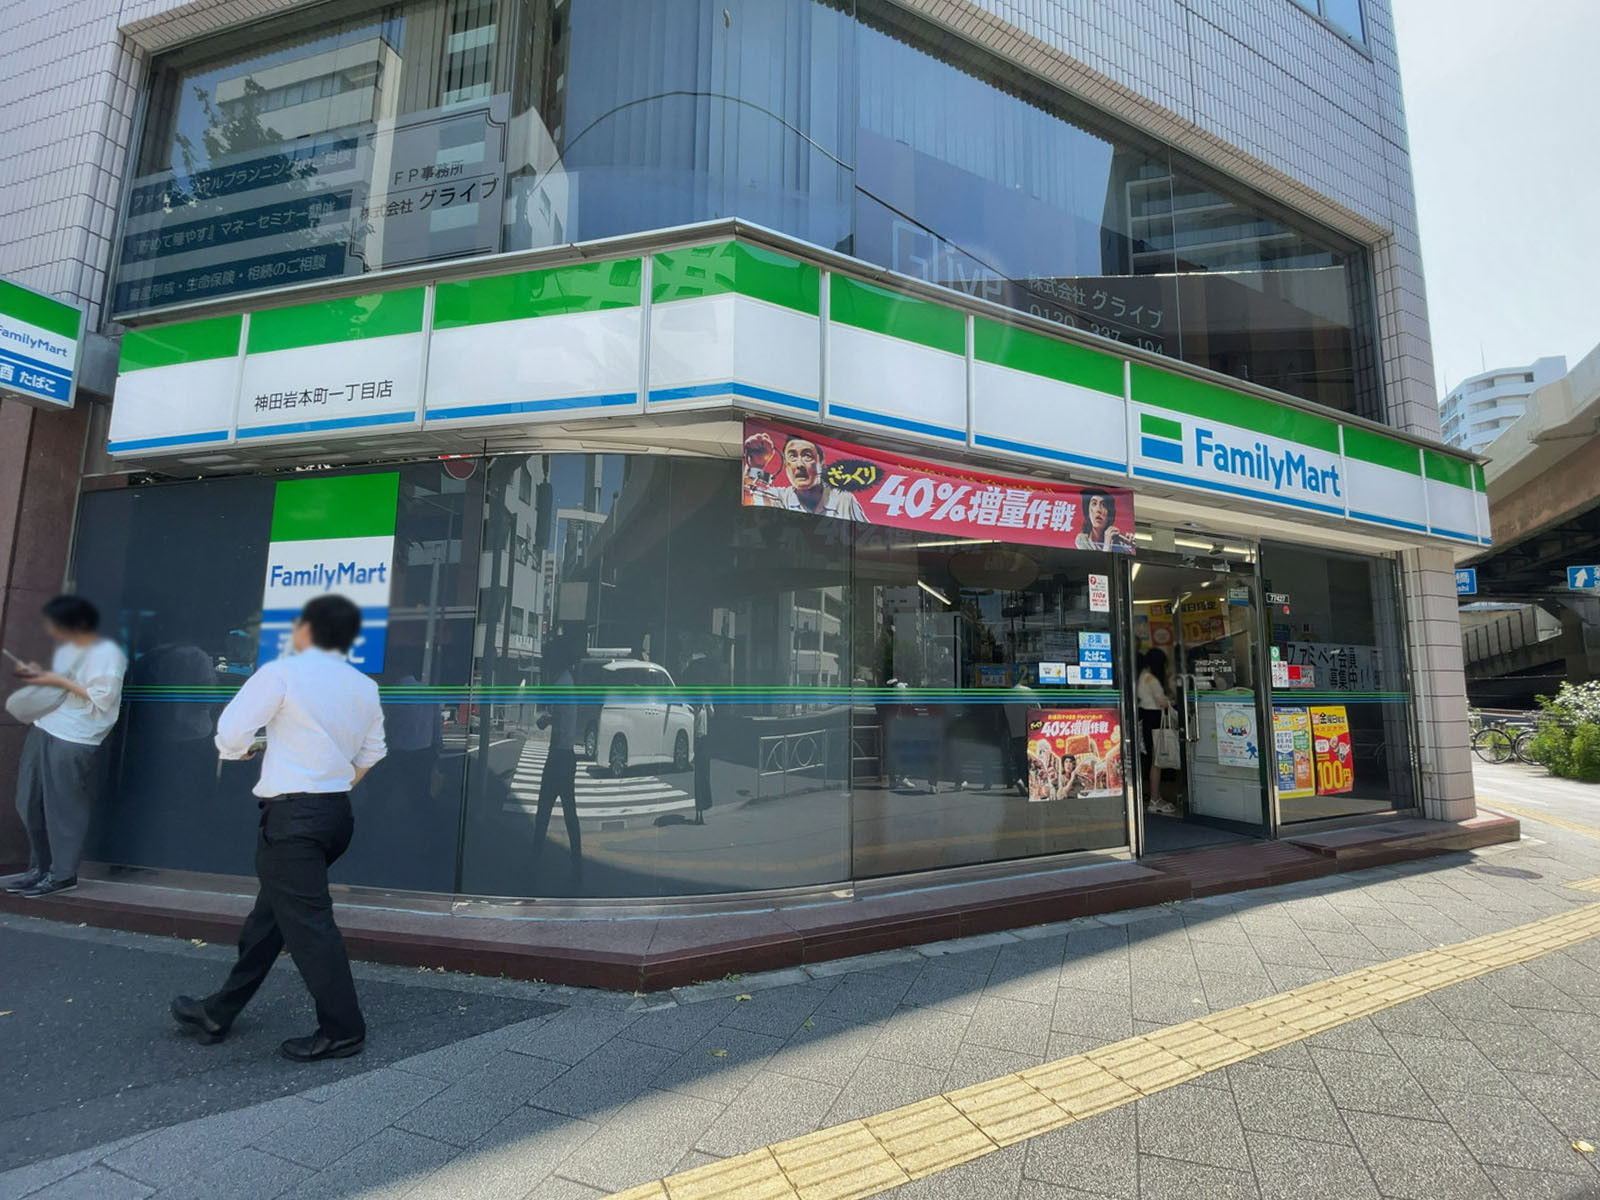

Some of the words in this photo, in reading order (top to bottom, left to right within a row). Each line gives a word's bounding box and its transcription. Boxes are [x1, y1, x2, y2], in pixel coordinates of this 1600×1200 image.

[360, 198, 414, 221] 株式会社
[420, 177, 499, 210] グライブ
[1028, 275, 1087, 306] 株式会社
[1092, 289, 1164, 329] グライブ
[19, 371, 56, 393] たばこ
[254, 379, 394, 413] 神田岩本町一丁目店
[828, 465, 877, 487] ざっくり
[1195, 427, 1341, 497] FamilyMart
[870, 474, 1077, 532] 40%増量作戦
[270, 561, 387, 592] FamilyMart
[1084, 650, 1107, 662] たばこ
